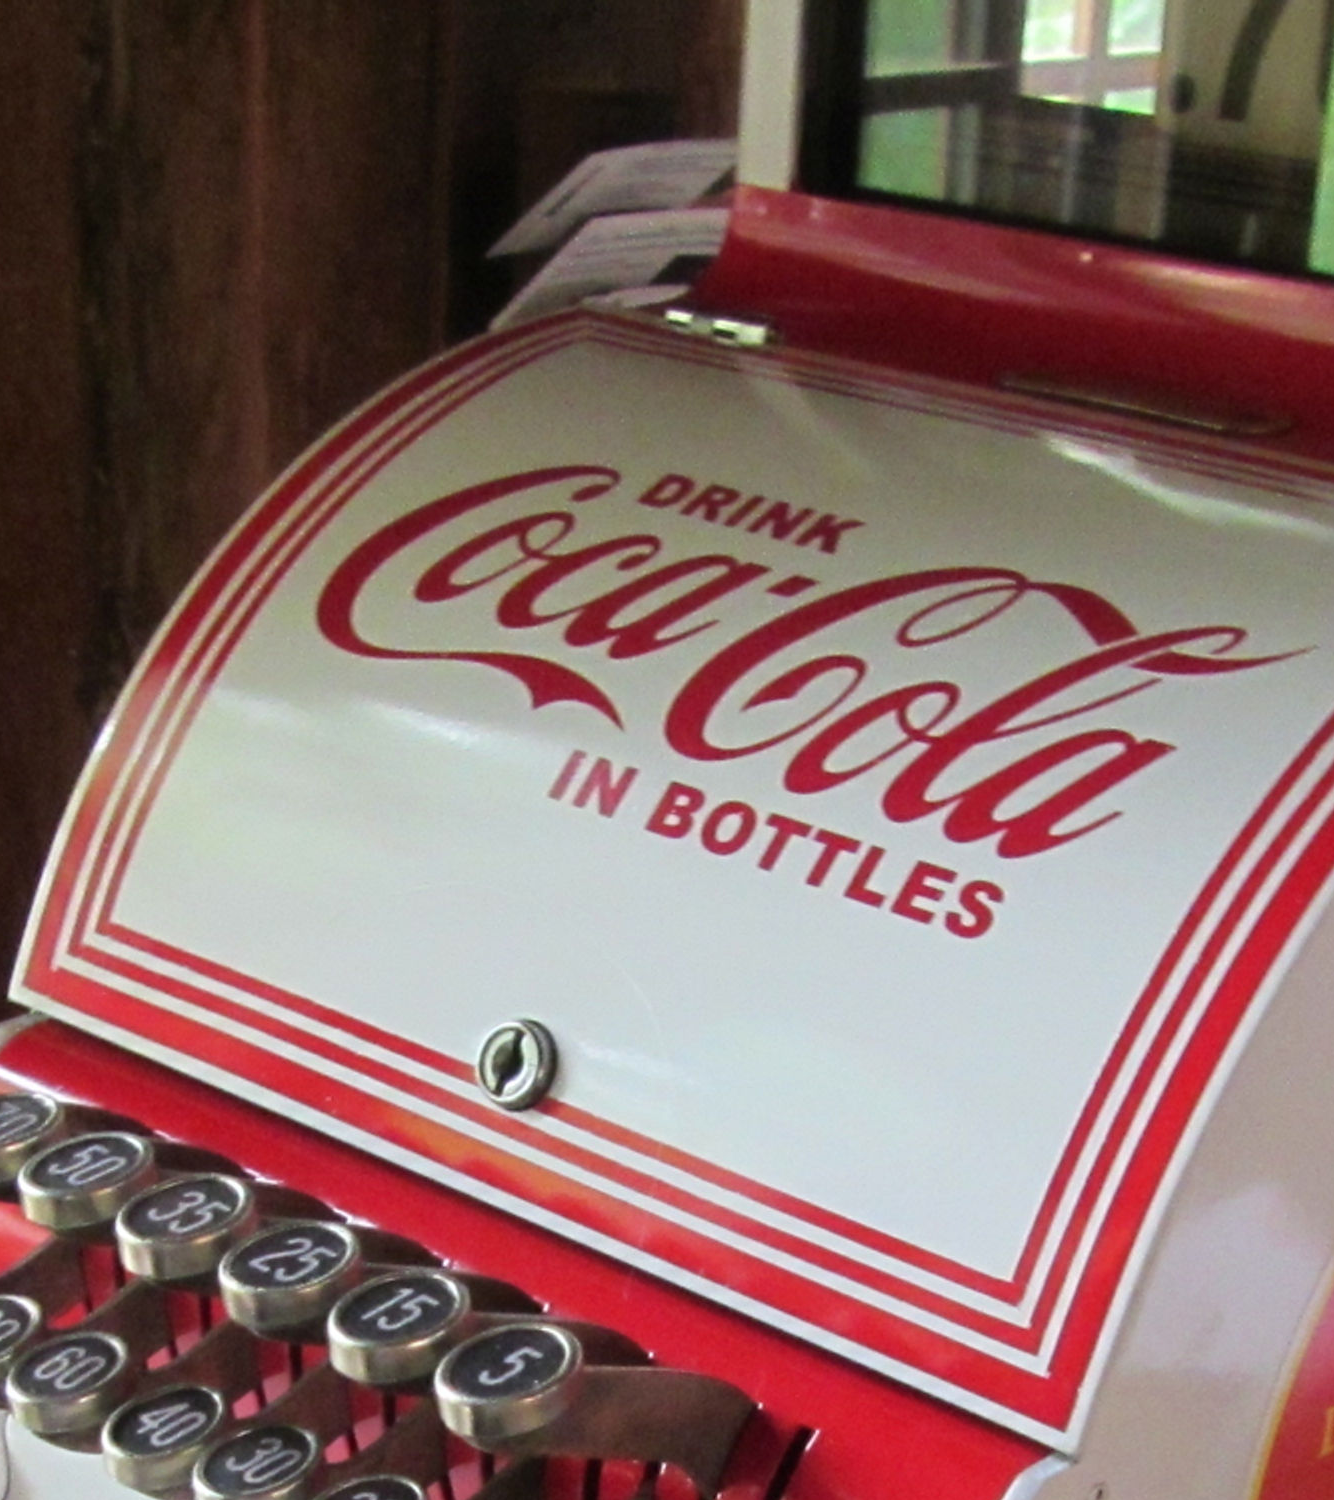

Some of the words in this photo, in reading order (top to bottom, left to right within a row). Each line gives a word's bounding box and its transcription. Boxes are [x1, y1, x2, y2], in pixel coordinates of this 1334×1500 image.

[638, 473, 864, 555] DRINK
[316, 464, 1319, 860] Coca-Cola
[546, 750, 639, 819] IN
[645, 784, 1006, 940] BOTTLES
[48, 1145, 127, 1186] 50
[147, 1190, 232, 1234] 35
[249, 1236, 336, 1283] 25
[359, 1286, 442, 1332] 15
[33, 1347, 107, 1390] 60
[478, 1345, 543, 1386] 5
[135, 1403, 208, 1447] 40
[224, 1437, 304, 1485] 30
